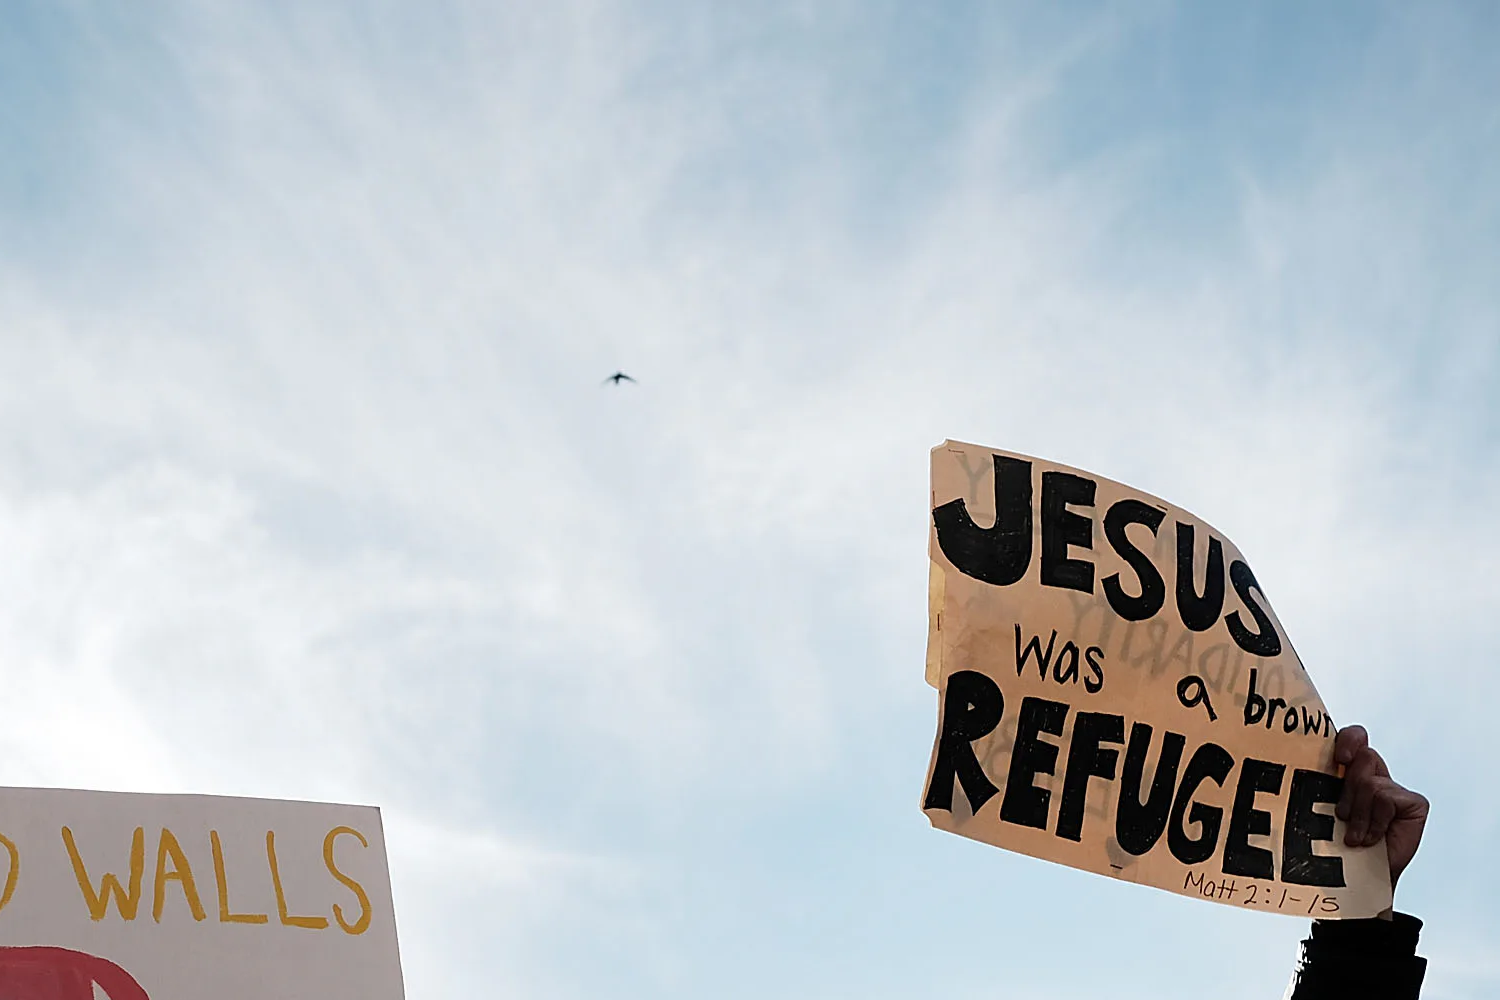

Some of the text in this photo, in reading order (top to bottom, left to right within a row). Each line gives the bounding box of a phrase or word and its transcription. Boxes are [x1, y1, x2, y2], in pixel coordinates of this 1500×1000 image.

[932, 454, 1283, 657] JESUS
[1177, 675, 1218, 722] a
[923, 670, 1347, 888] REFUGEE
[62, 826, 372, 935] WALLS
[1183, 870, 1238, 900] Matt
